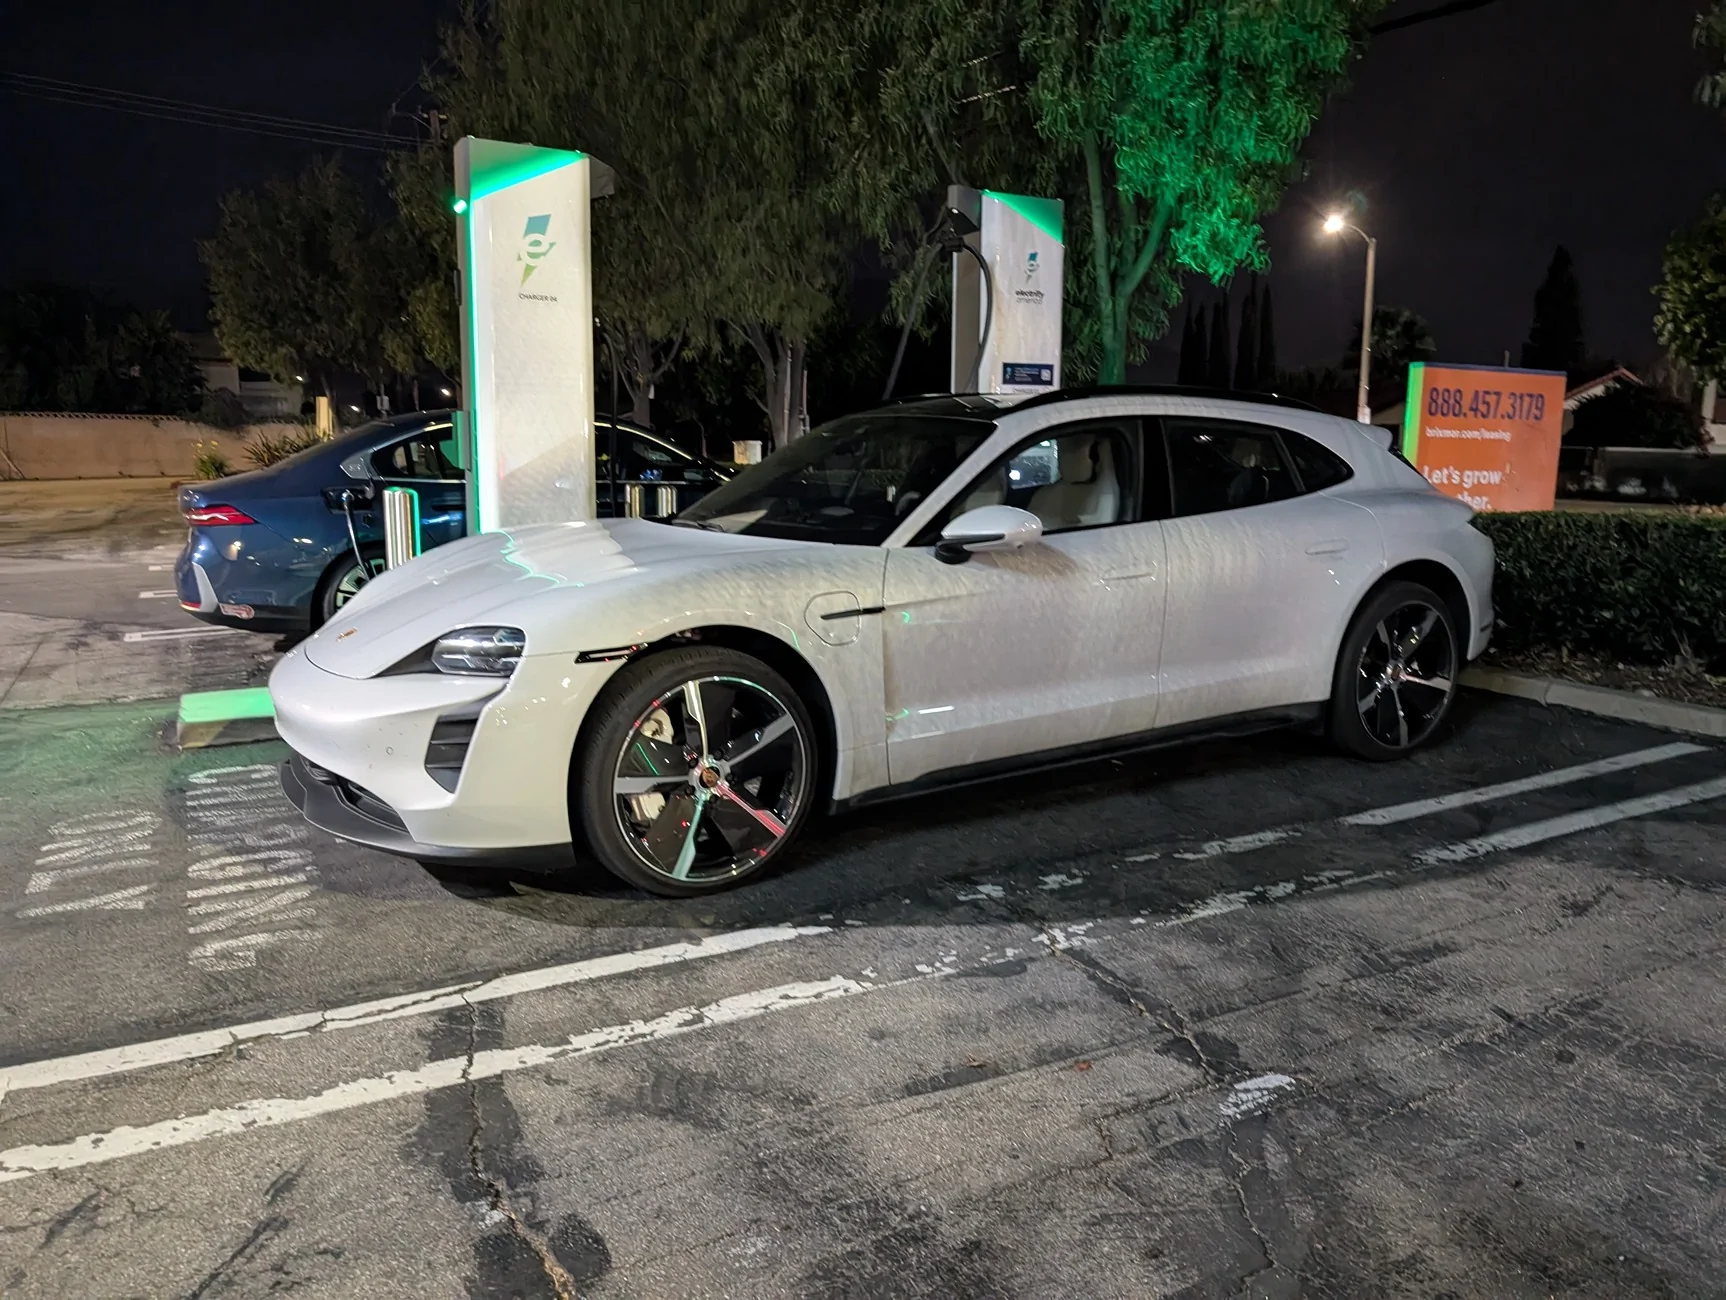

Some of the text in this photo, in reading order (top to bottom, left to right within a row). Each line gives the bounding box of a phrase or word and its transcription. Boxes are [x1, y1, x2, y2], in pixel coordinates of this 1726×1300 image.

[518, 293, 549, 302] CHARGER
[1015, 289, 1045, 299] electrify
[1428, 387, 1545, 421] 888.457.3179
[1422, 465, 1502, 489] Let's grow
[15, 809, 161, 918] ONLY
